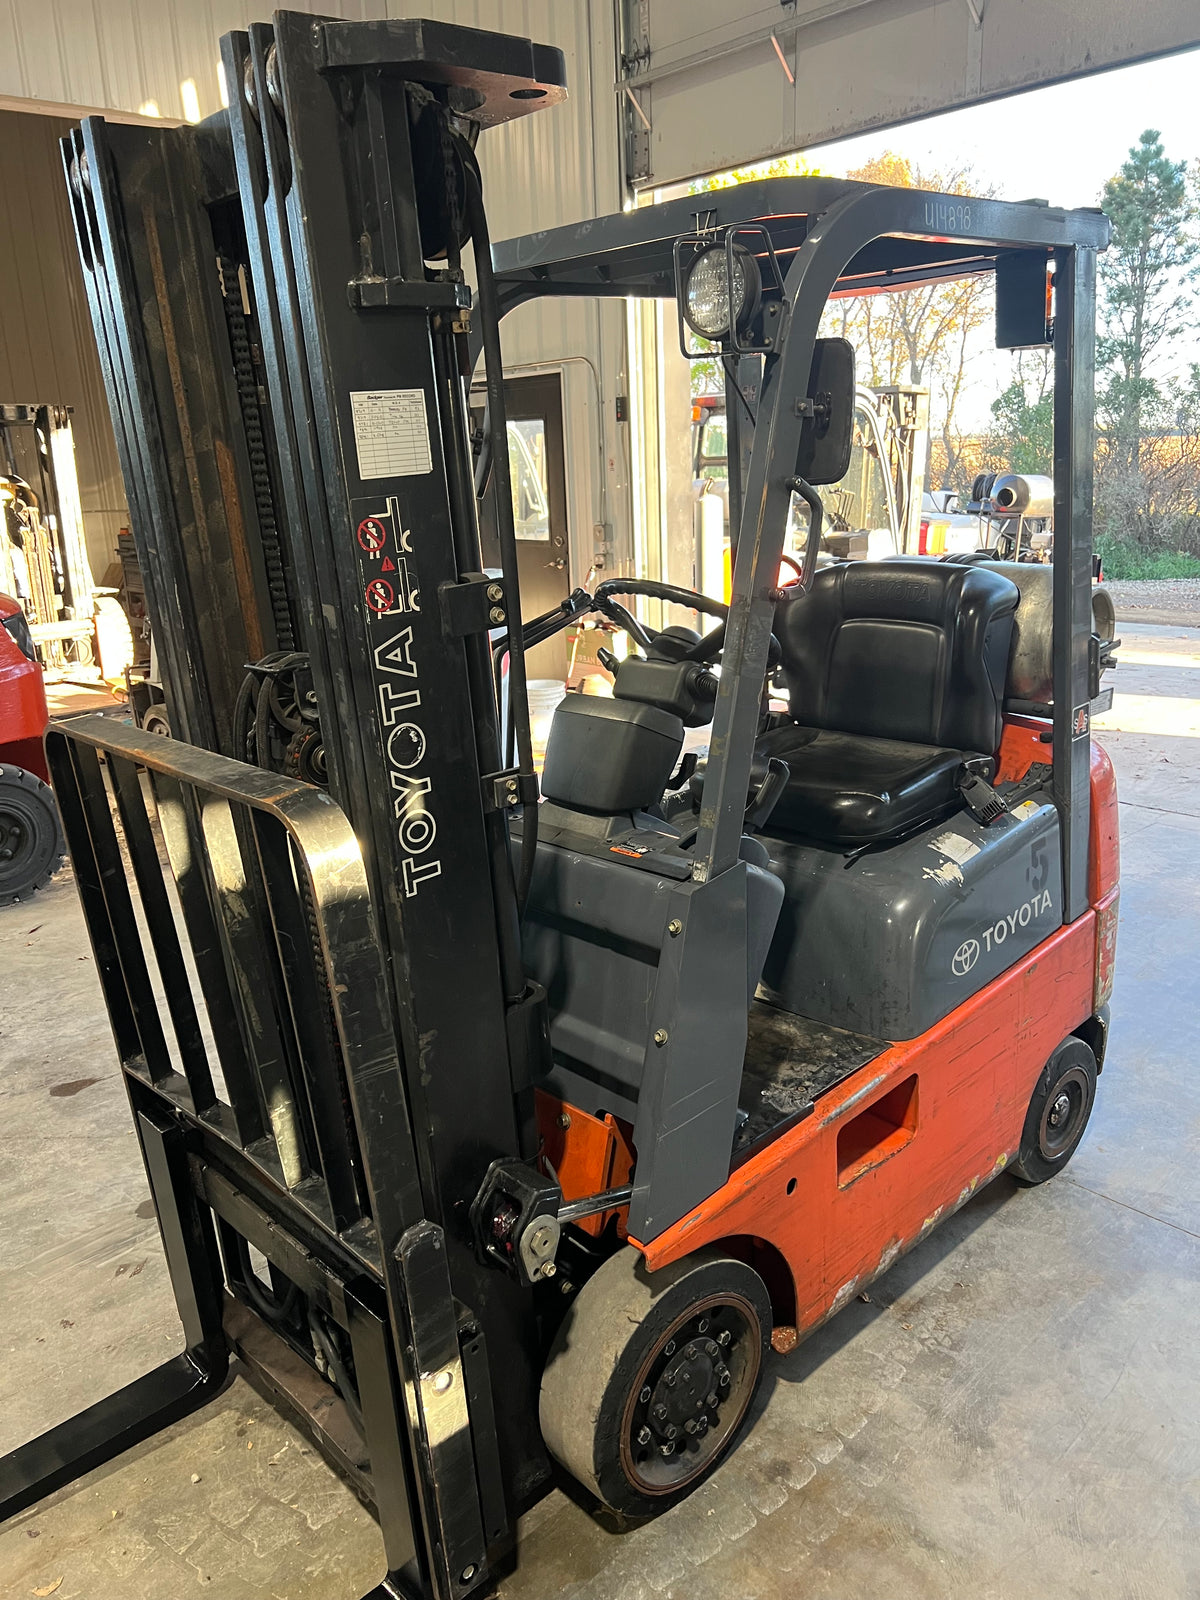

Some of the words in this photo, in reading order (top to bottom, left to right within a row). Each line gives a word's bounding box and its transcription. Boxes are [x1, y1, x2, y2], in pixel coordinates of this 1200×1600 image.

[925, 202, 971, 231] U14898
[853, 579, 931, 602] TOYOTA
[374, 625, 441, 898] TOYOTA
[982, 889, 1053, 952] TOYOTA
